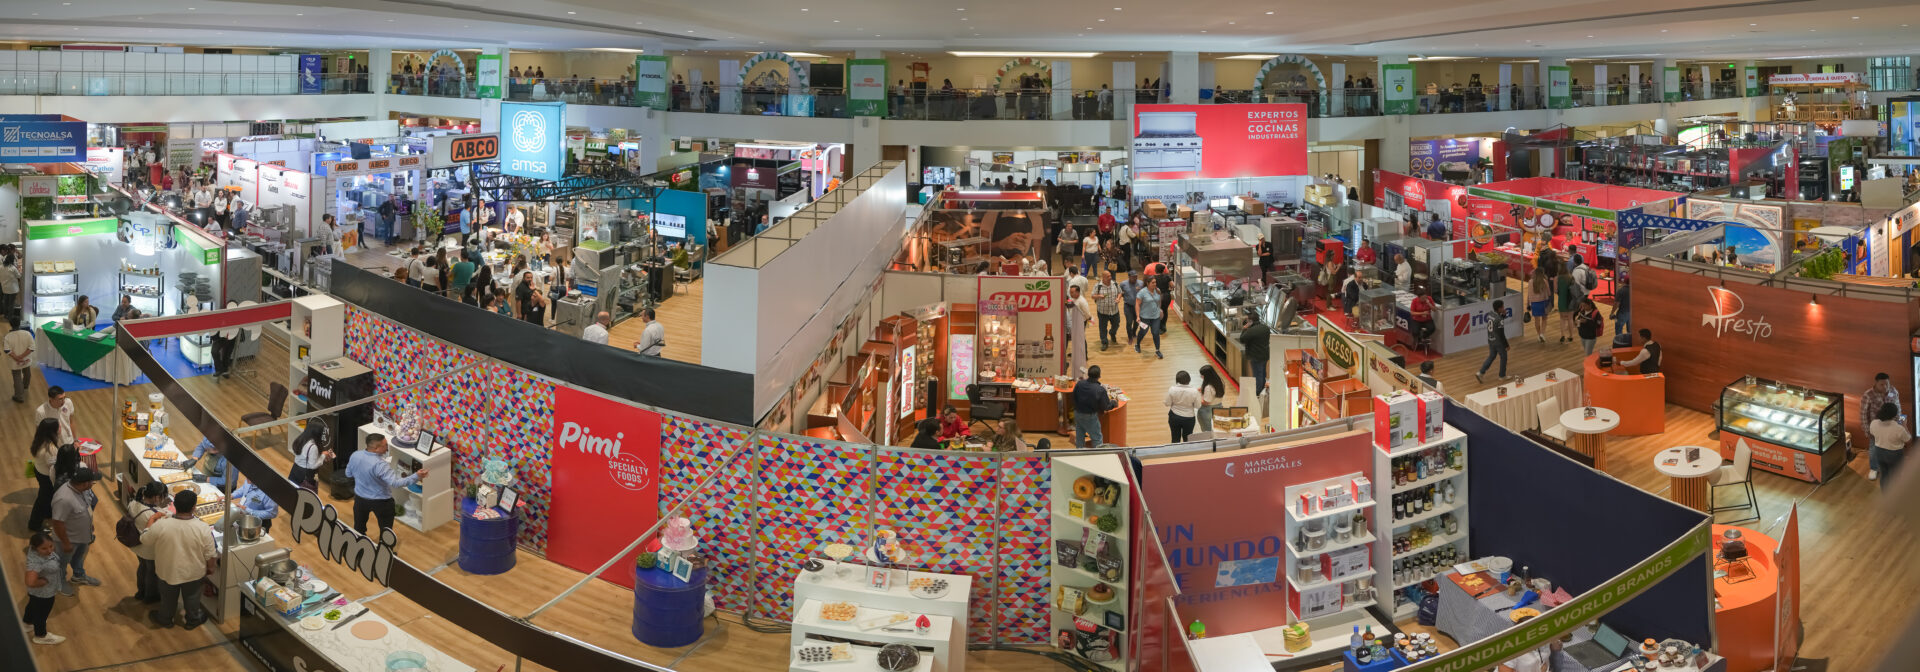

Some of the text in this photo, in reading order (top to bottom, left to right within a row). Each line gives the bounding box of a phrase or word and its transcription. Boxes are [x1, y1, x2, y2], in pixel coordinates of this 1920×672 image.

[1248, 111, 1298, 119] EXPERTOS
[20, 131, 73, 139] TECNOALSA
[1248, 124, 1298, 133] COCINAS
[1248, 132, 1299, 140] INDUSTRIALES
[455, 139, 495, 159] ABCO
[337, 163, 358, 171] ABCO
[370, 161, 389, 169] ABCO
[512, 160, 547, 173] amsa
[1703, 285, 1772, 342] Presto
[1325, 335, 1352, 366] ALESSI
[309, 378, 333, 400] Pimi
[559, 421, 624, 459] Pimi
[608, 460, 649, 476] SPECIALTY
[1244, 455, 1286, 468] MARCAS
[1244, 459, 1303, 475] MUNDIALES
[617, 470, 642, 483] FOODS
[291, 487, 397, 587] Pimi
[1154, 523, 1194, 545] UN
[1173, 580, 1284, 608] PERIENCIAS
[1434, 556, 1672, 672] MUNDIALES WORLD BRANDS
